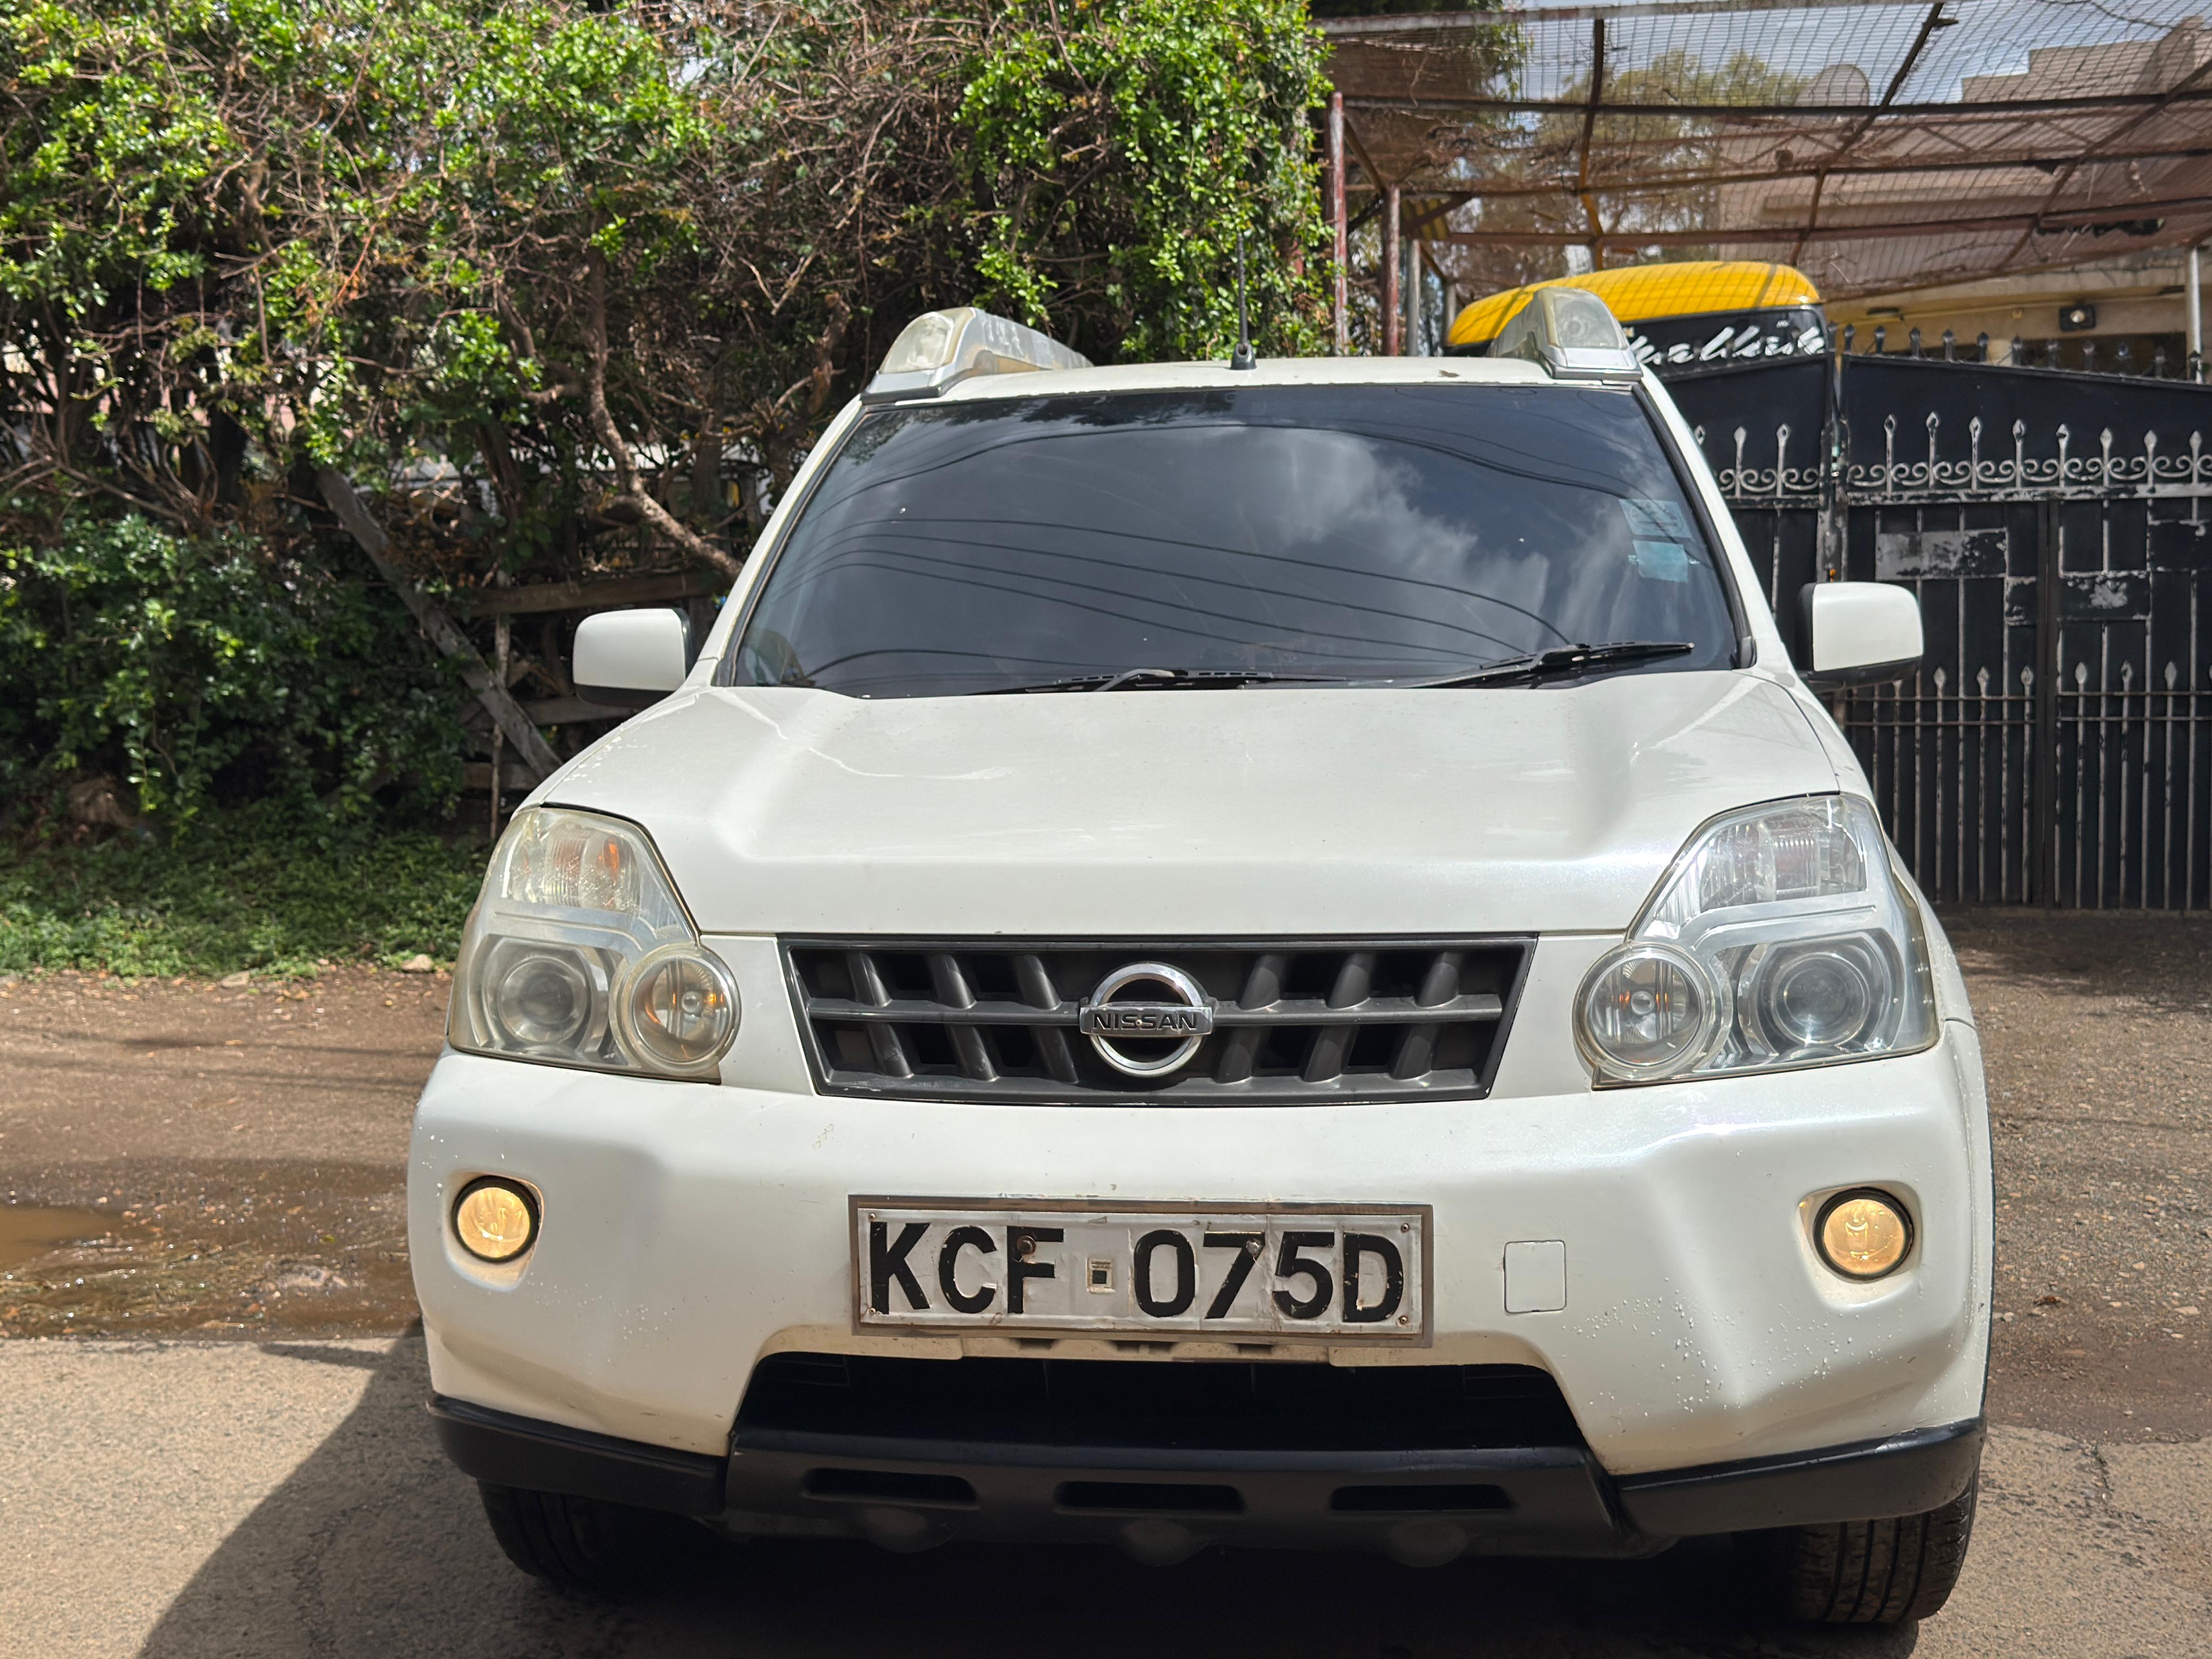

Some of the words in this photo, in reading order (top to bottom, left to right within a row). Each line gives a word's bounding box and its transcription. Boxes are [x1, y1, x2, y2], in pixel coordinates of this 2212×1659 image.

[1093, 1012, 1197, 1030] NISSAN
[869, 1221, 1063, 1314] KCF
[1133, 1229, 1404, 1323] 075D
